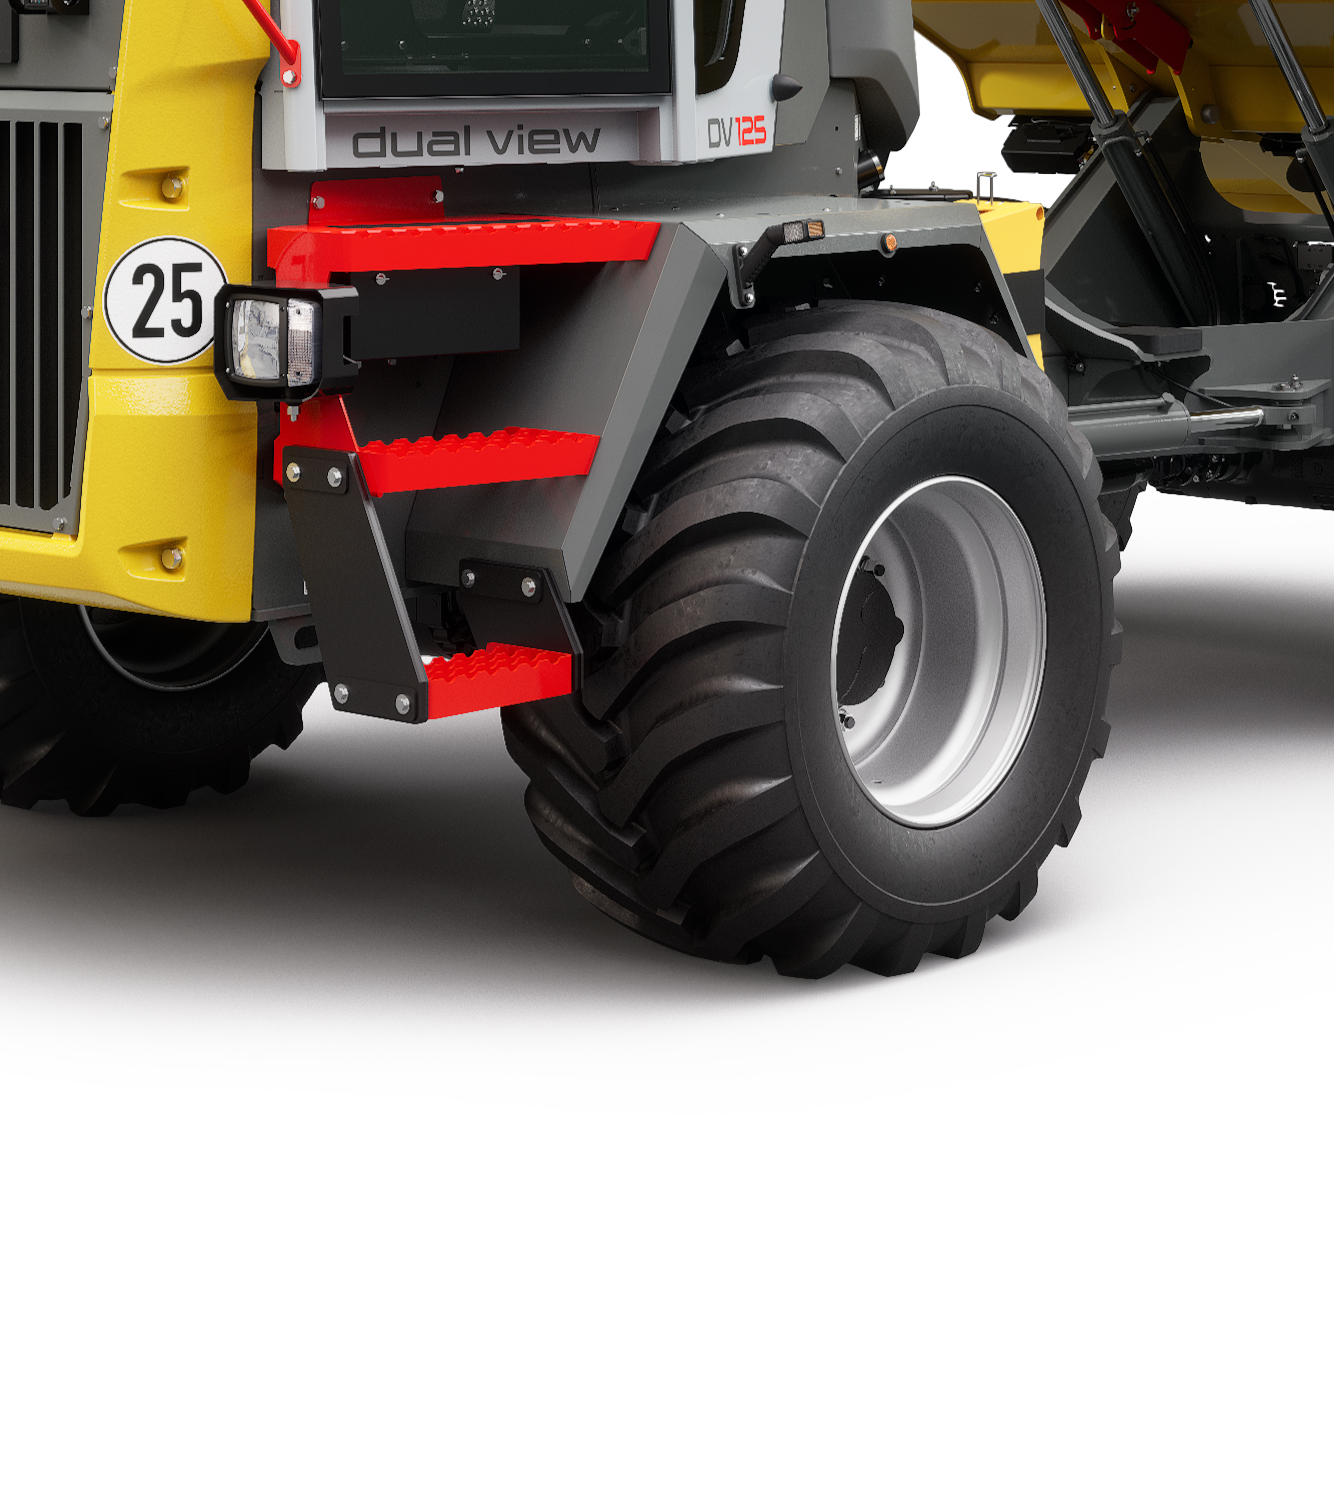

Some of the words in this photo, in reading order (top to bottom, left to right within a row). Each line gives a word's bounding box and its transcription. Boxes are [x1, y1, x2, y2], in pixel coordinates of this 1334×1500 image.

[352, 125, 471, 159] dual
[485, 124, 601, 155] view
[131, 262, 203, 339] 25
